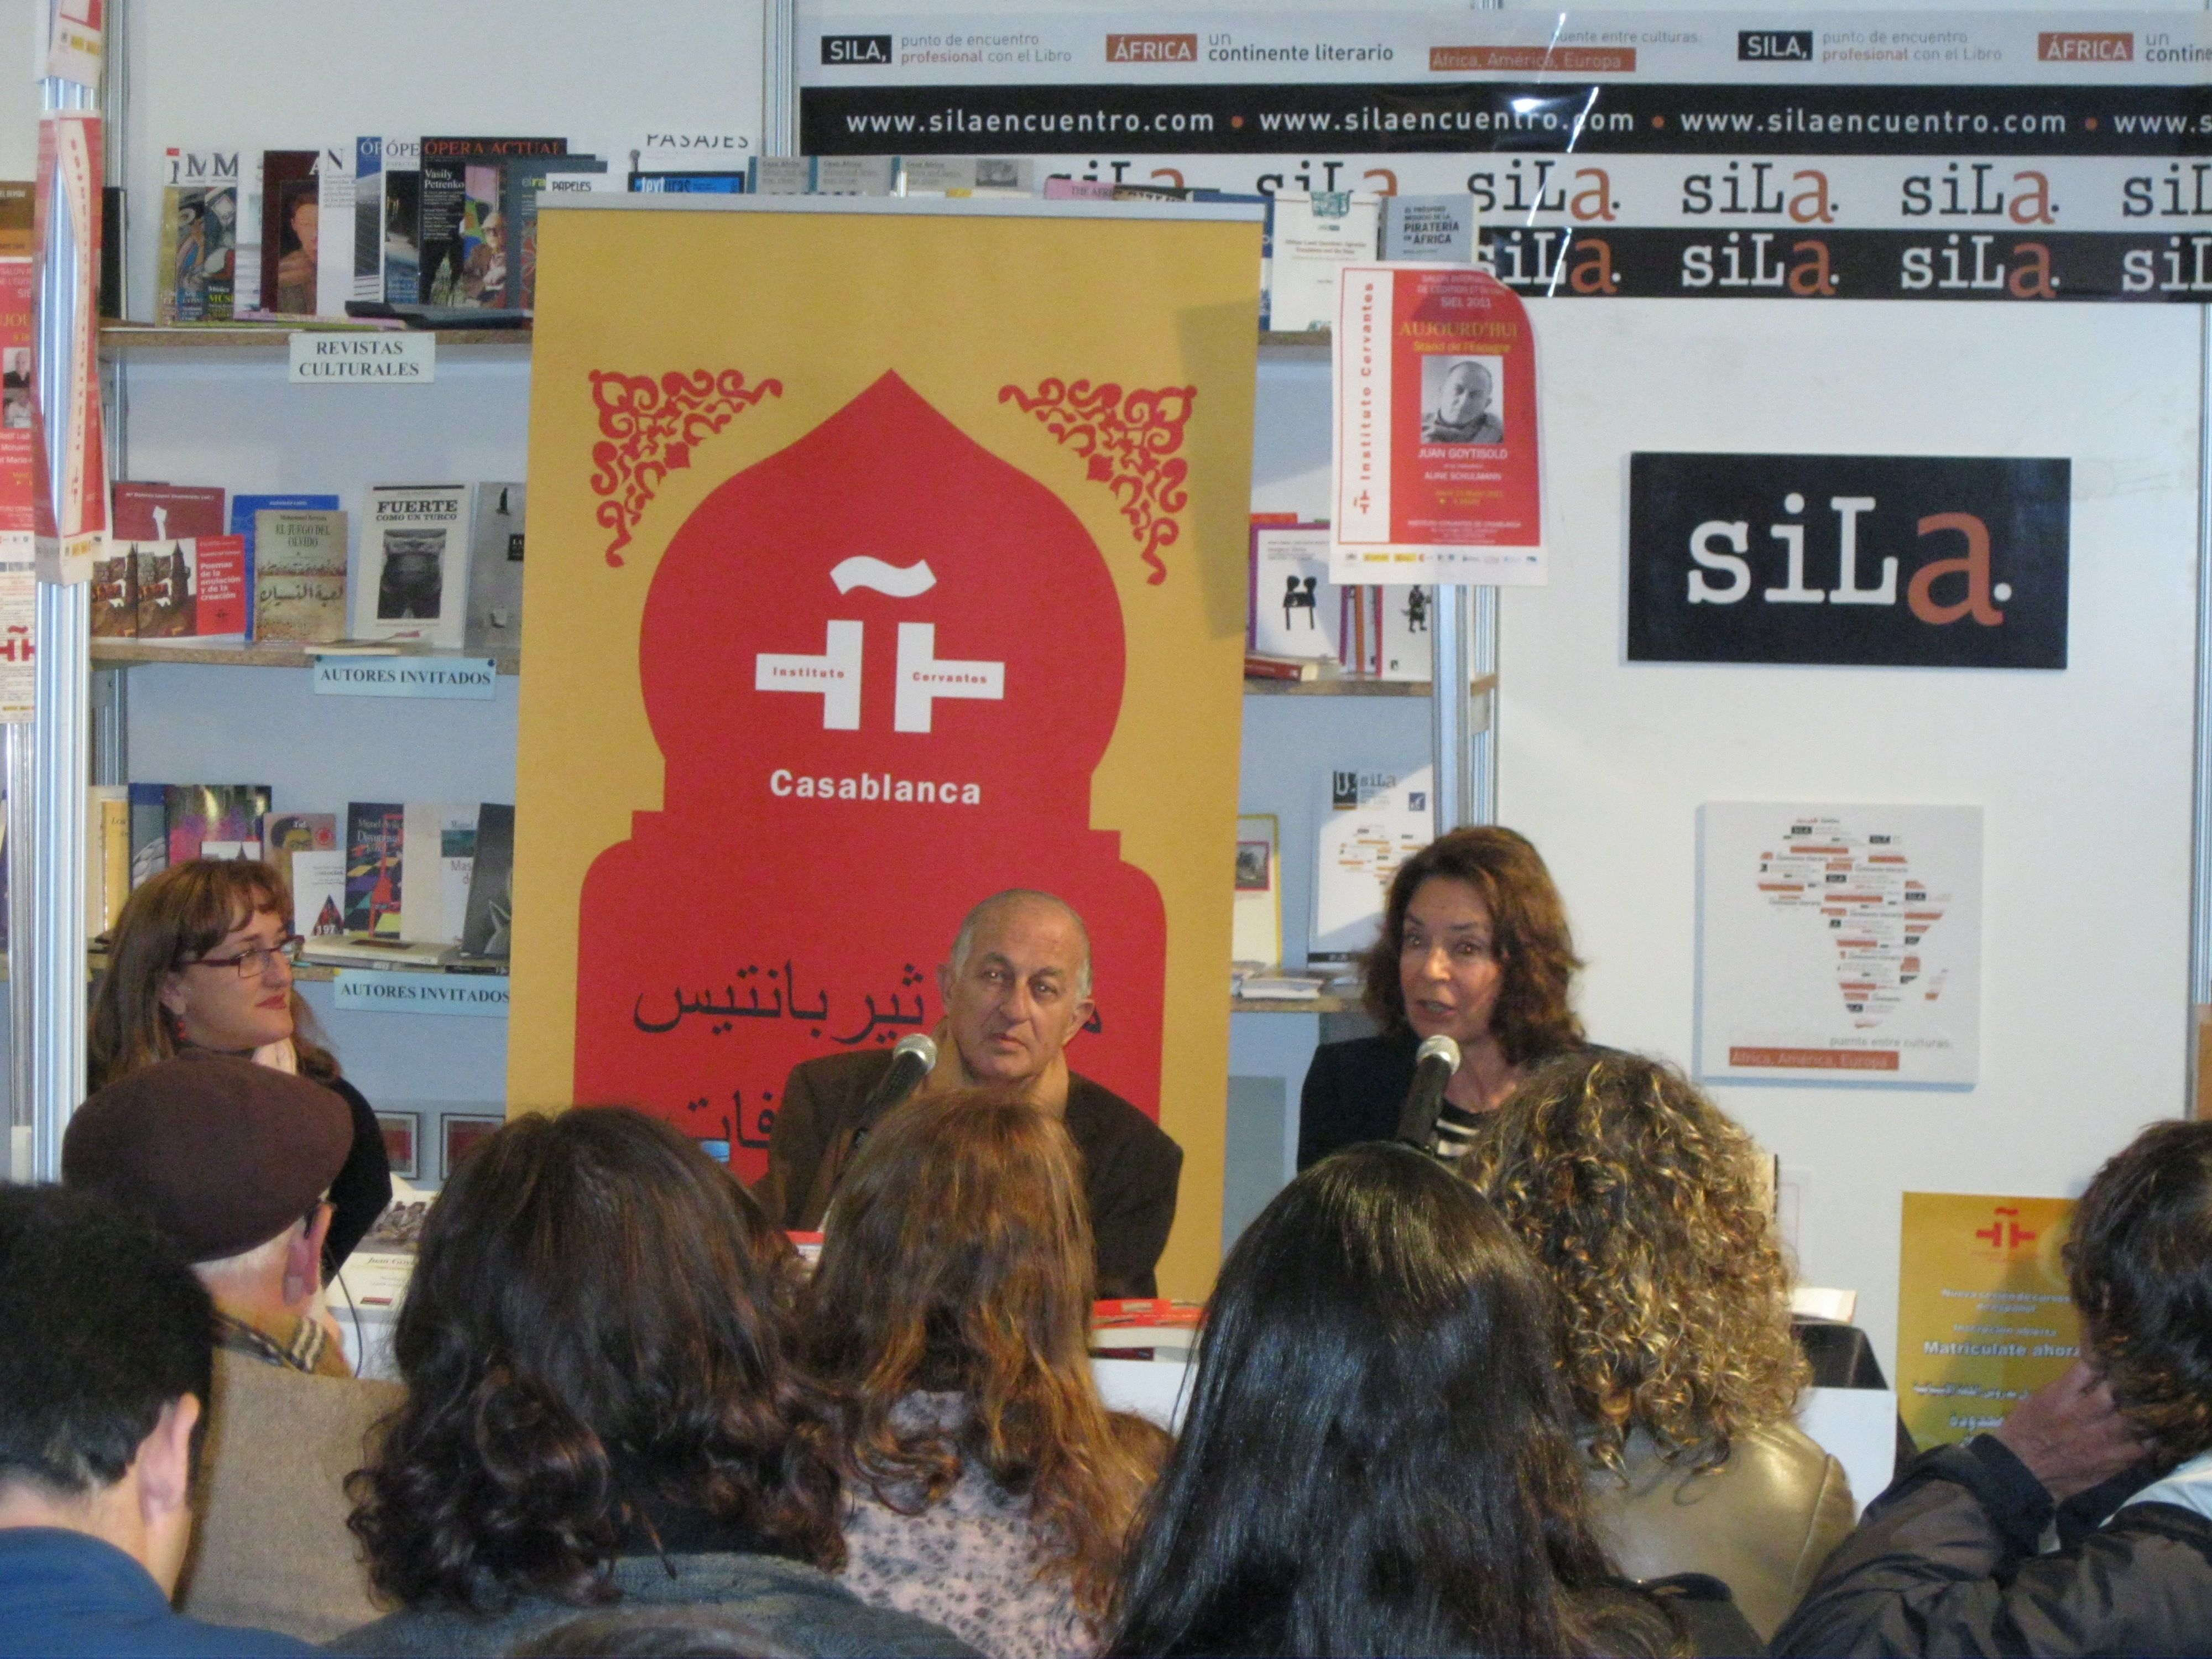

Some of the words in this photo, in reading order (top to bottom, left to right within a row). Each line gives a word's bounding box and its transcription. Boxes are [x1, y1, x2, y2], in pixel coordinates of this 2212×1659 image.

[901, 36, 941, 48] punto
[946, 34, 963, 45] de
[967, 34, 1039, 45] encuentro
[1209, 32, 1232, 44] un
[1601, 32, 1637, 43] entre
[1823, 32, 1864, 45] punto
[1870, 31, 1886, 42] de
[1892, 32, 1968, 43] encuentro
[2146, 33, 2169, 46] un
[1114, 36, 1191, 60] ÁFRICA
[1208, 46, 1309, 62] continente
[1315, 44, 1393, 61] literario
[1823, 48, 1907, 61] profesional
[1913, 50, 1940, 60] con
[1945, 48, 1958, 60] el
[1963, 48, 2002, 60] Libro
[2048, 35, 2127, 59] ÁFRICA
[901, 50, 983, 64] profesional
[988, 53, 1014, 62] con
[1019, 50, 1030, 61] el
[1035, 50, 1072, 62] Libro
[846, 109, 1213, 132] www.silaencuentro.com
[1260, 107, 1634, 132] www.silaencuentro.com
[1681, 108, 2066, 133] www.silaencuentro.com
[425, 139, 483, 155] ÓPERA
[646, 133, 749, 149] PASAJES
[424, 169, 452, 180] Vasily
[424, 179, 465, 190] Petrenko
[551, 181, 591, 192] PAPELES
[1467, 158, 1620, 221] siLa.
[1681, 161, 1839, 224] siLa.
[1901, 163, 2059, 225] siLa.
[1681, 232, 1839, 296] siLa.
[1901, 234, 2059, 299] siLa.
[1361, 283, 1373, 376] Cervantes
[316, 341, 403, 354] REVISTAS
[299, 362, 419, 377] CULTURALES
[1418, 448, 1445, 458] JUAN
[377, 500, 458, 513] FUERTE
[1688, 493, 2012, 627] siLa.
[200, 592, 236, 601] creación
[321, 669, 395, 682] AUTORES
[401, 670, 491, 685] INVITADOS
[774, 667, 844, 679] Instituto
[913, 672, 987, 684] Cervantes
[770, 770, 982, 805] Casablanca
[342, 983, 416, 998] AUTORES
[421, 987, 509, 1003] INVITADOS
[1830, 1036, 1867, 1047] puente
[1872, 1037, 1900, 1047] entre
